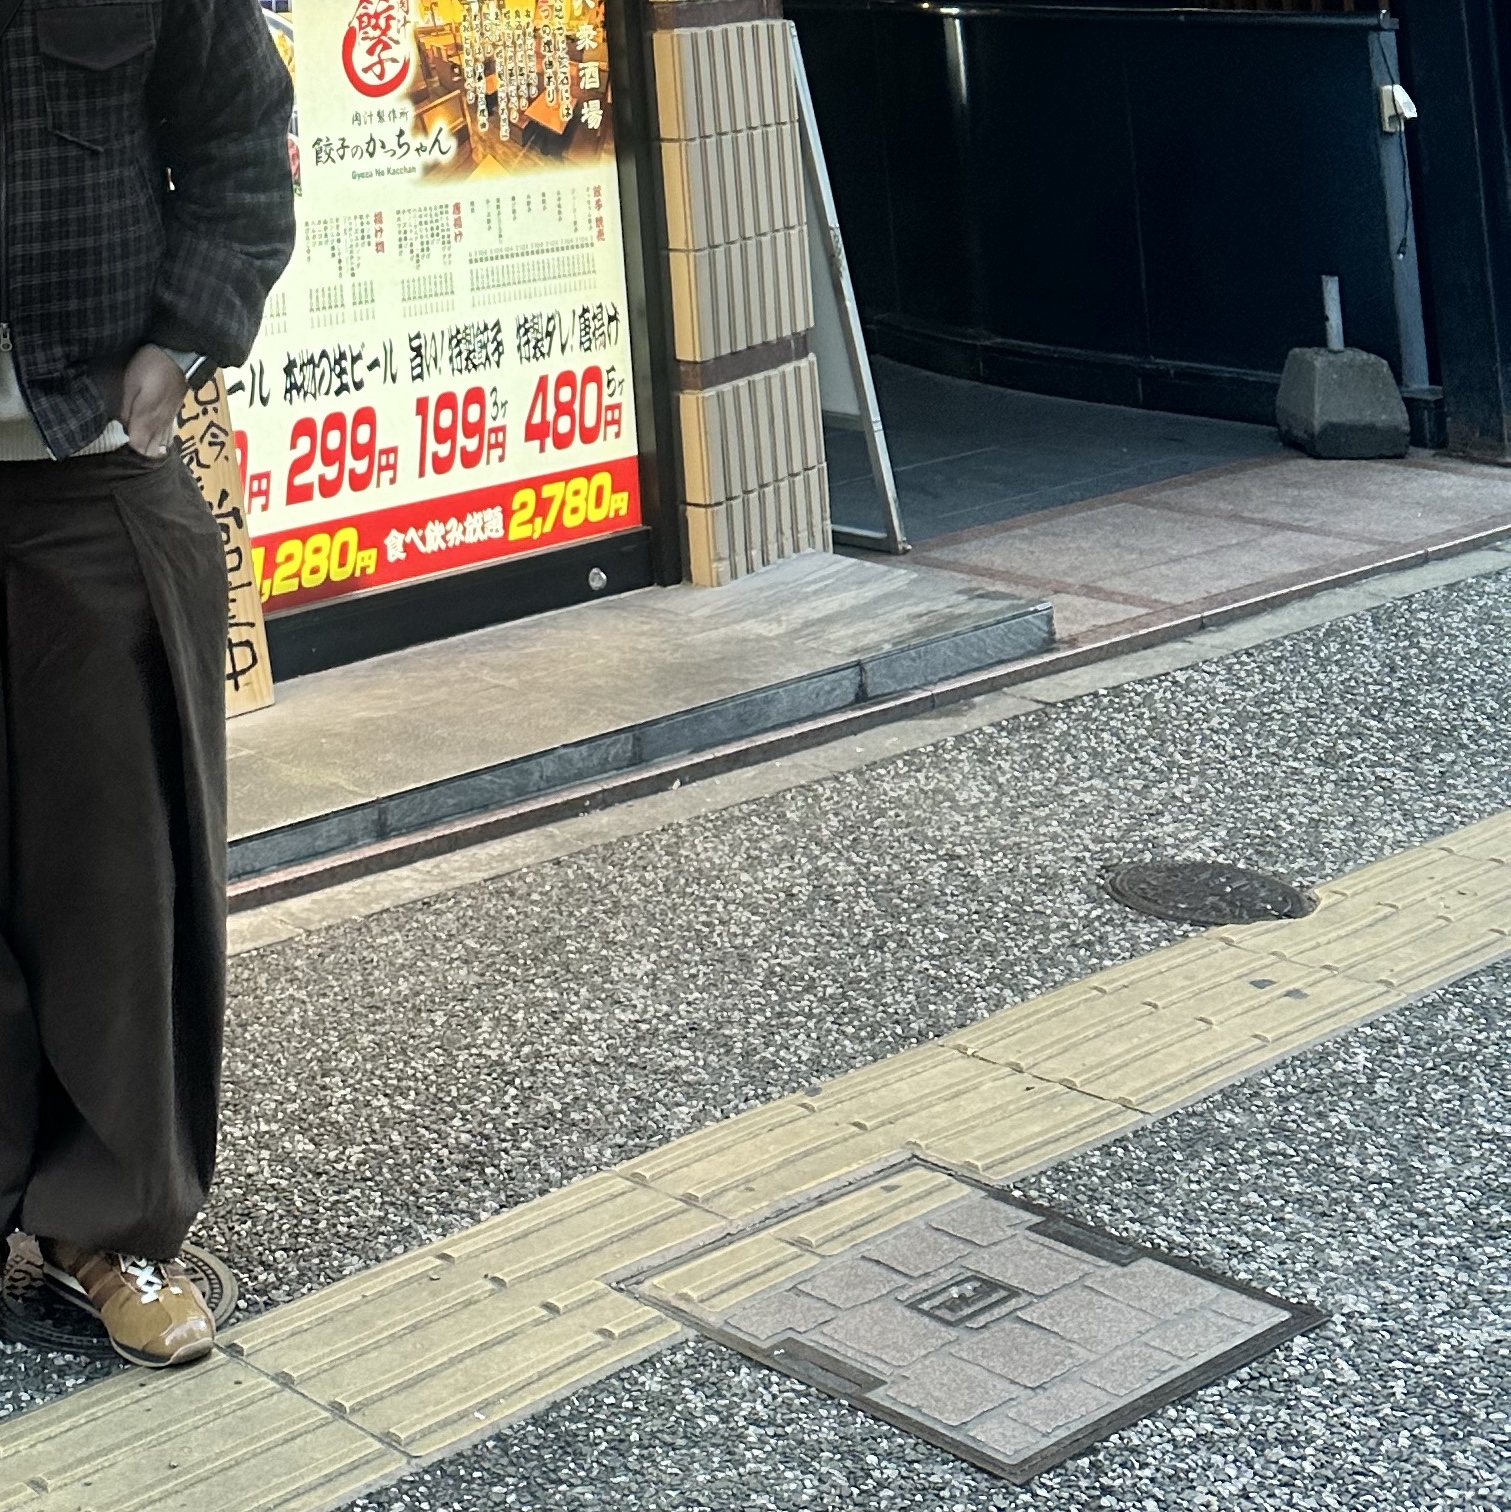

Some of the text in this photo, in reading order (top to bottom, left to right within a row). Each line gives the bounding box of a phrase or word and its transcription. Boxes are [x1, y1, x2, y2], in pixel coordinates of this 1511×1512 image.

[312, 128, 452, 166] 餃子のかっちゃん
[283, 338, 397, 403] 本物の生ビール
[286, 405, 399, 507] 299円
[384, 506, 505, 563] 食べ飲み放題
[507, 471, 629, 542] 2,780円
